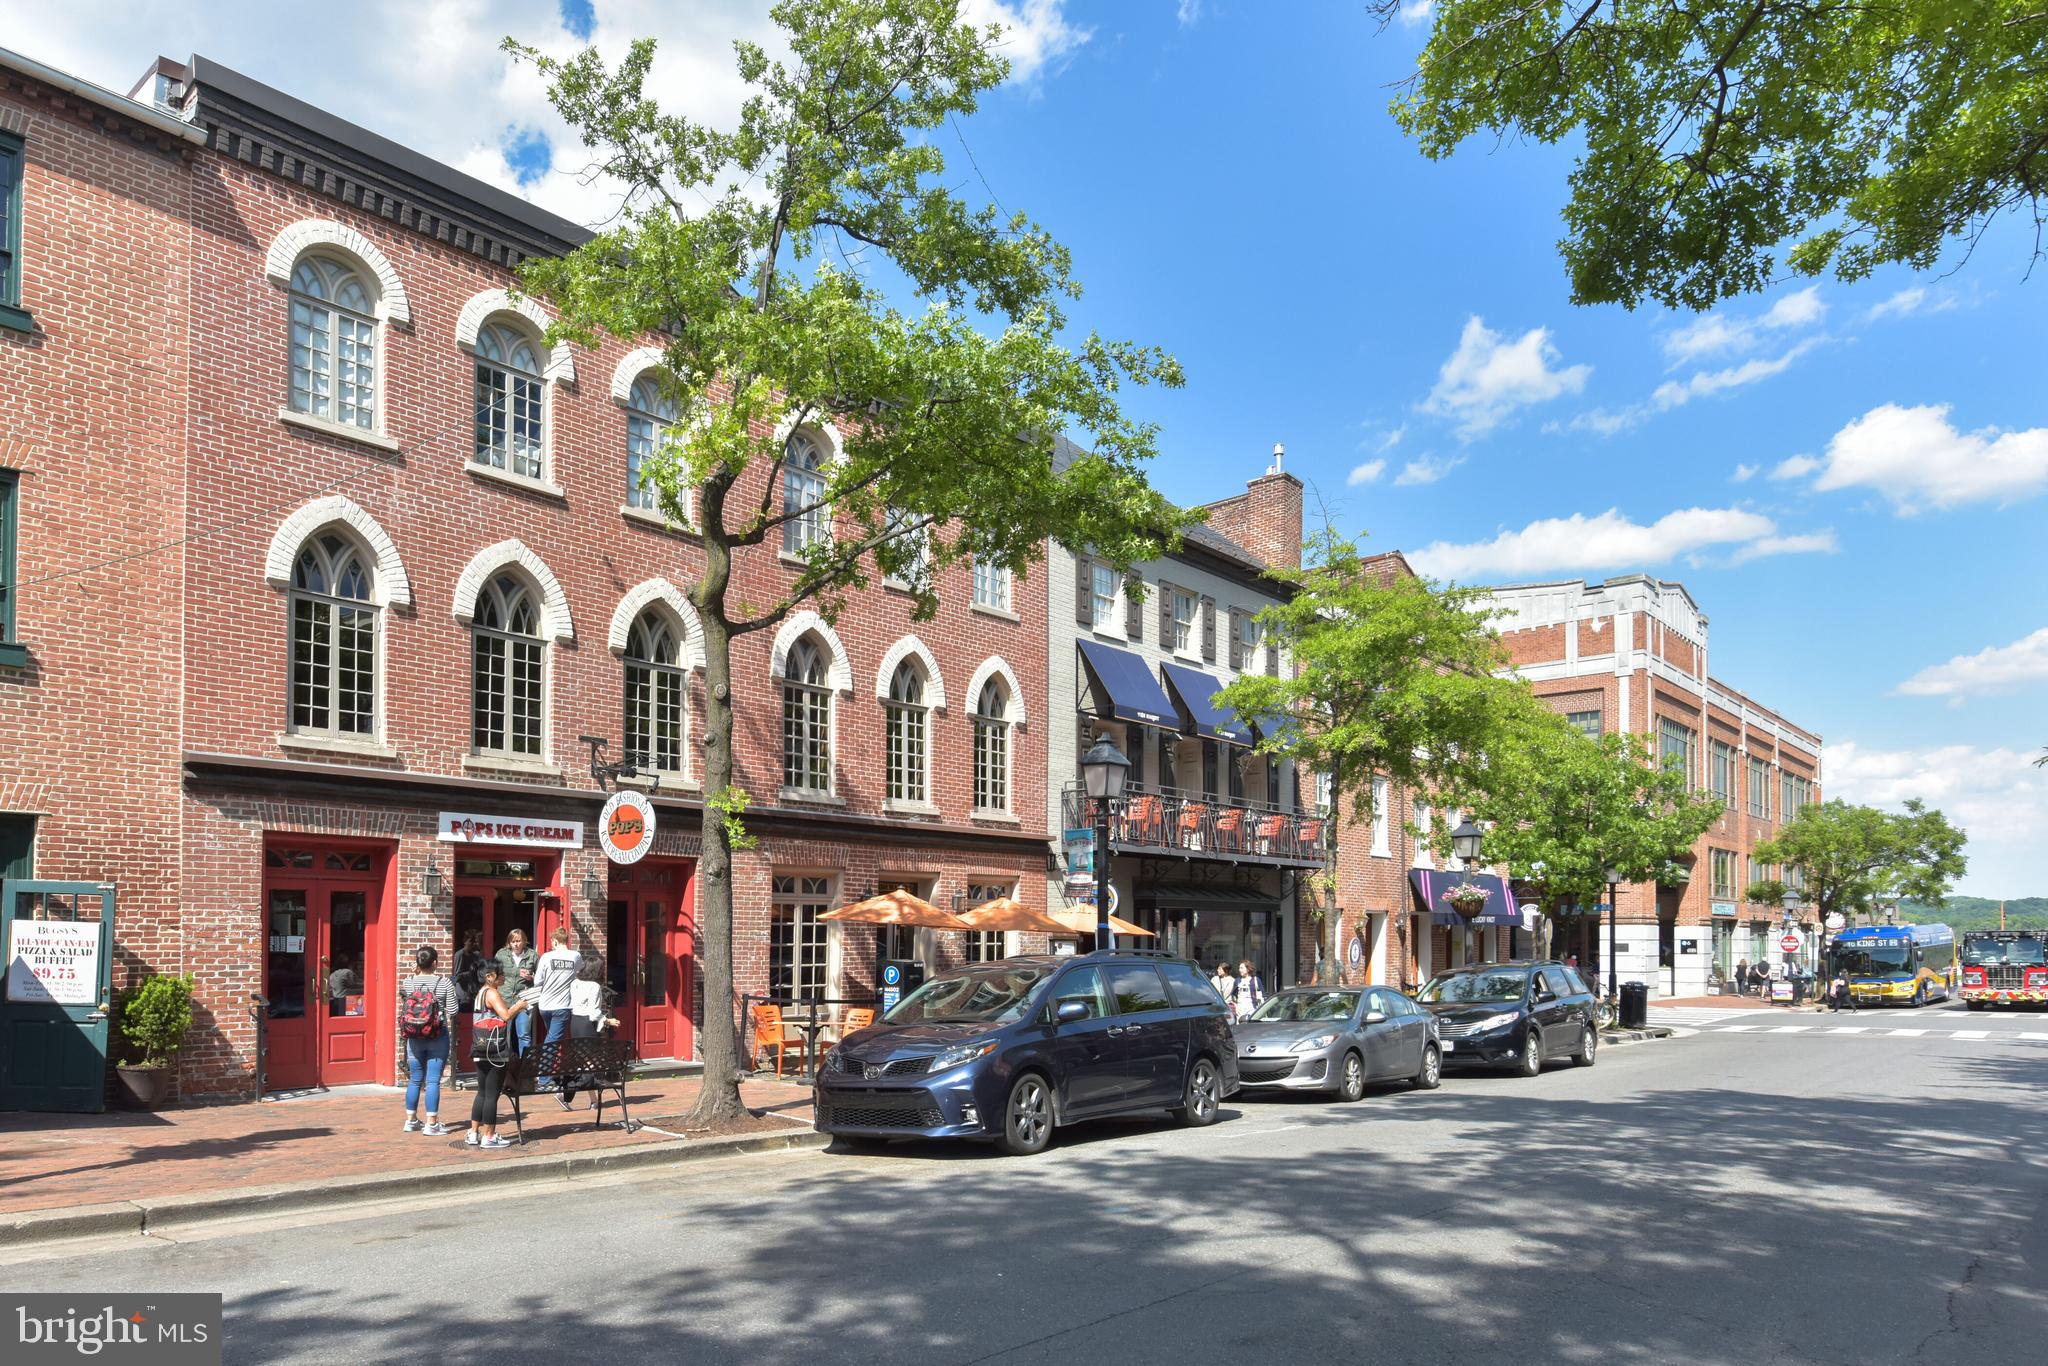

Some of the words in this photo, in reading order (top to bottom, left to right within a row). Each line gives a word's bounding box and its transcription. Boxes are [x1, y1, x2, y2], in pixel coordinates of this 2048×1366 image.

[496, 823, 521, 839] ICE
[523, 825, 575, 841] CREAM
[17, 947, 47, 955] PIZZA
[60, 948, 93, 956] SALAD
[35, 956, 74, 965] BUFFET
[33, 967, 76, 980] $9.75
[888, 969, 896, 982] P
